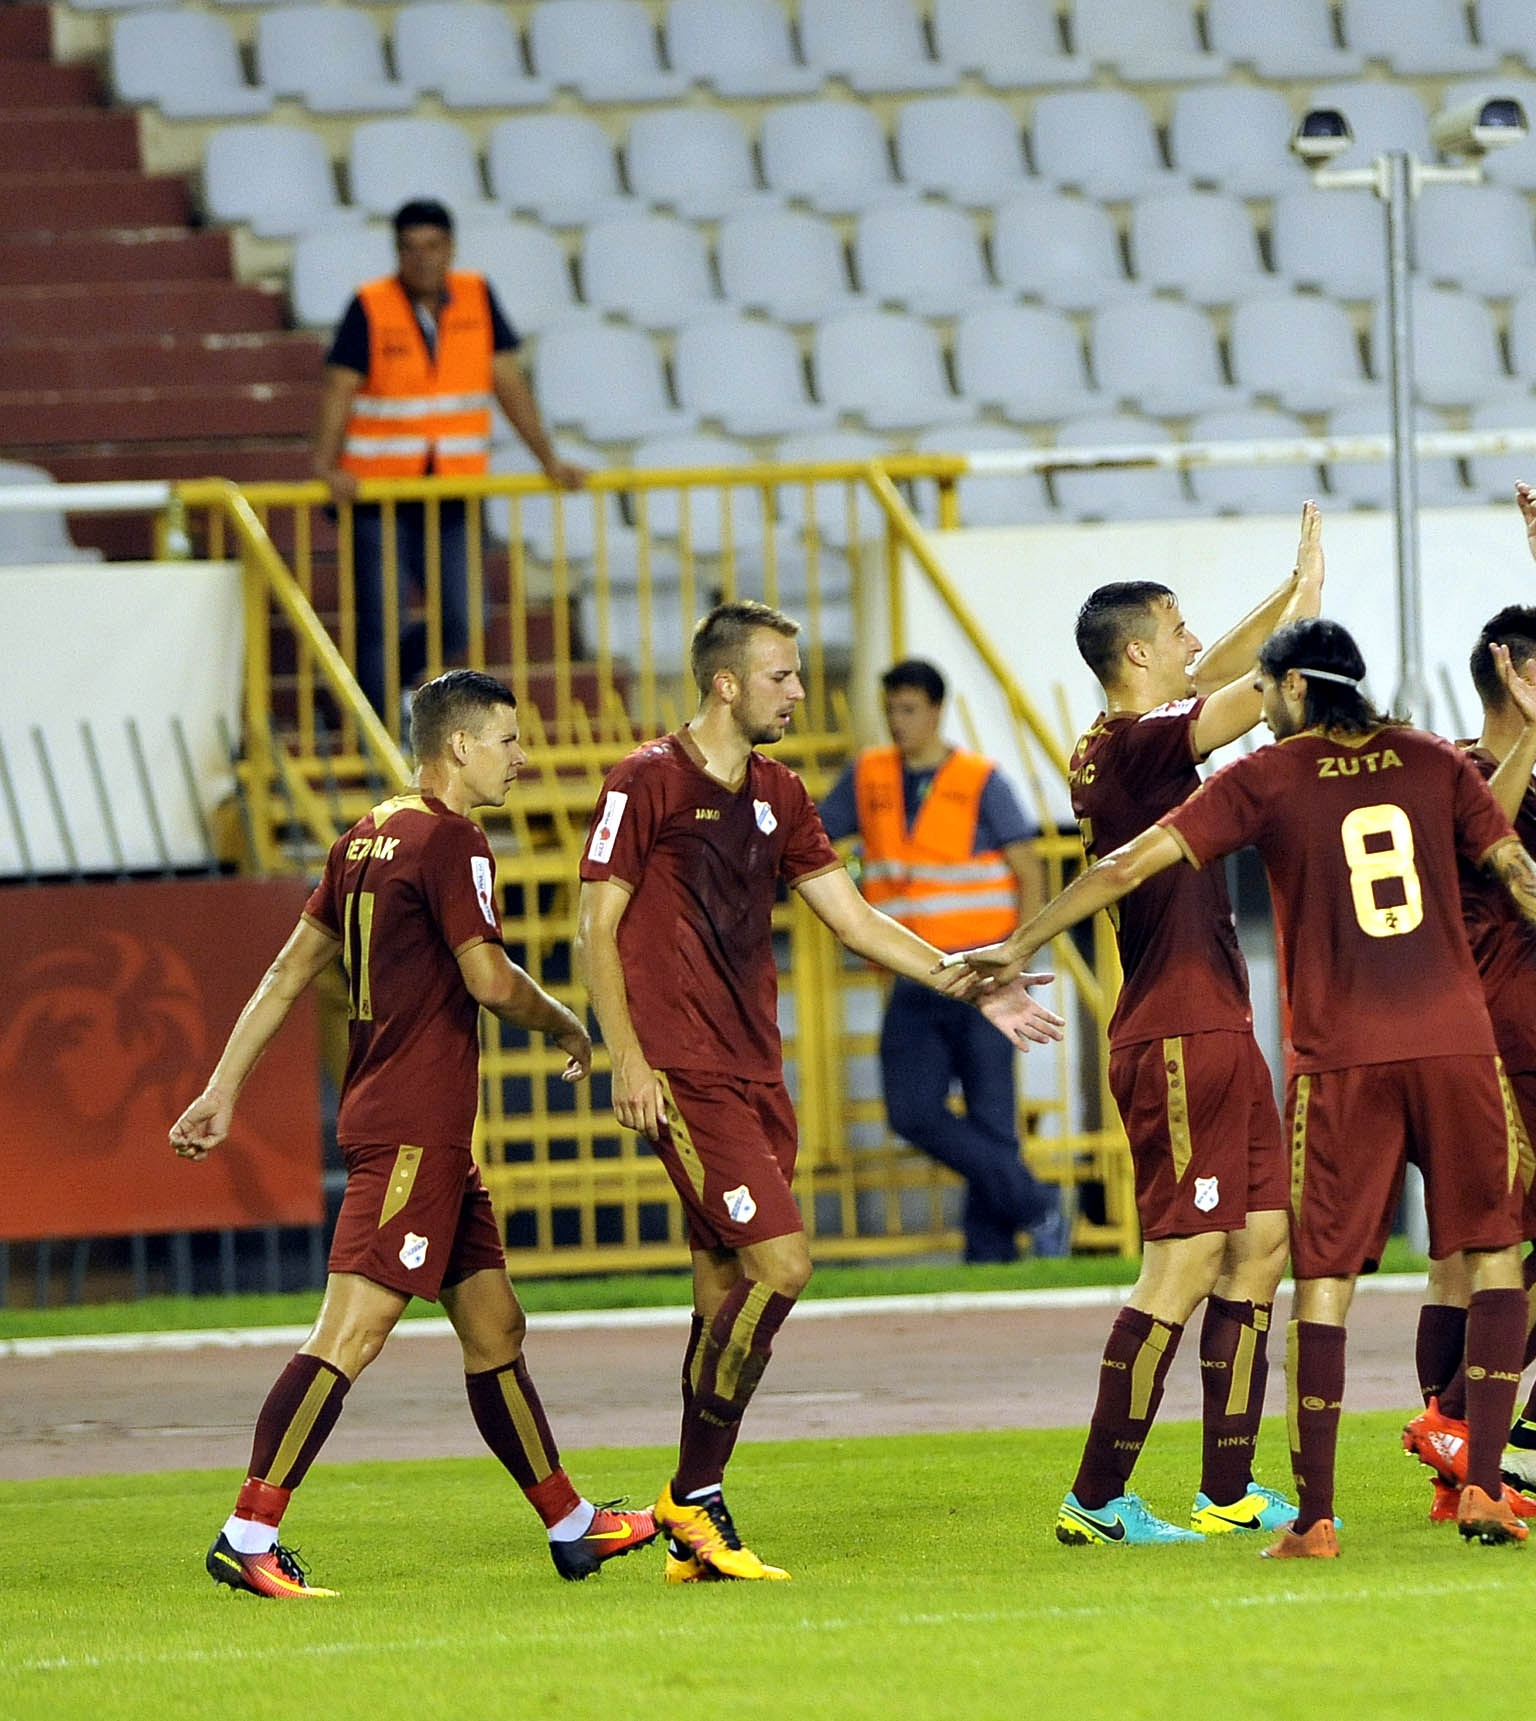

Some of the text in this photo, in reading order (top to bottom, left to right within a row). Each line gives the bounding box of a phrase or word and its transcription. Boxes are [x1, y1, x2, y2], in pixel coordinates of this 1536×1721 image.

[1316, 749, 1404, 779] ZUTA
[1341, 803, 1424, 938] 8
[1101, 1359, 1127, 1370] AKO
[1201, 1360, 1228, 1369] AKO
[1217, 1435, 1250, 1449] HNK
